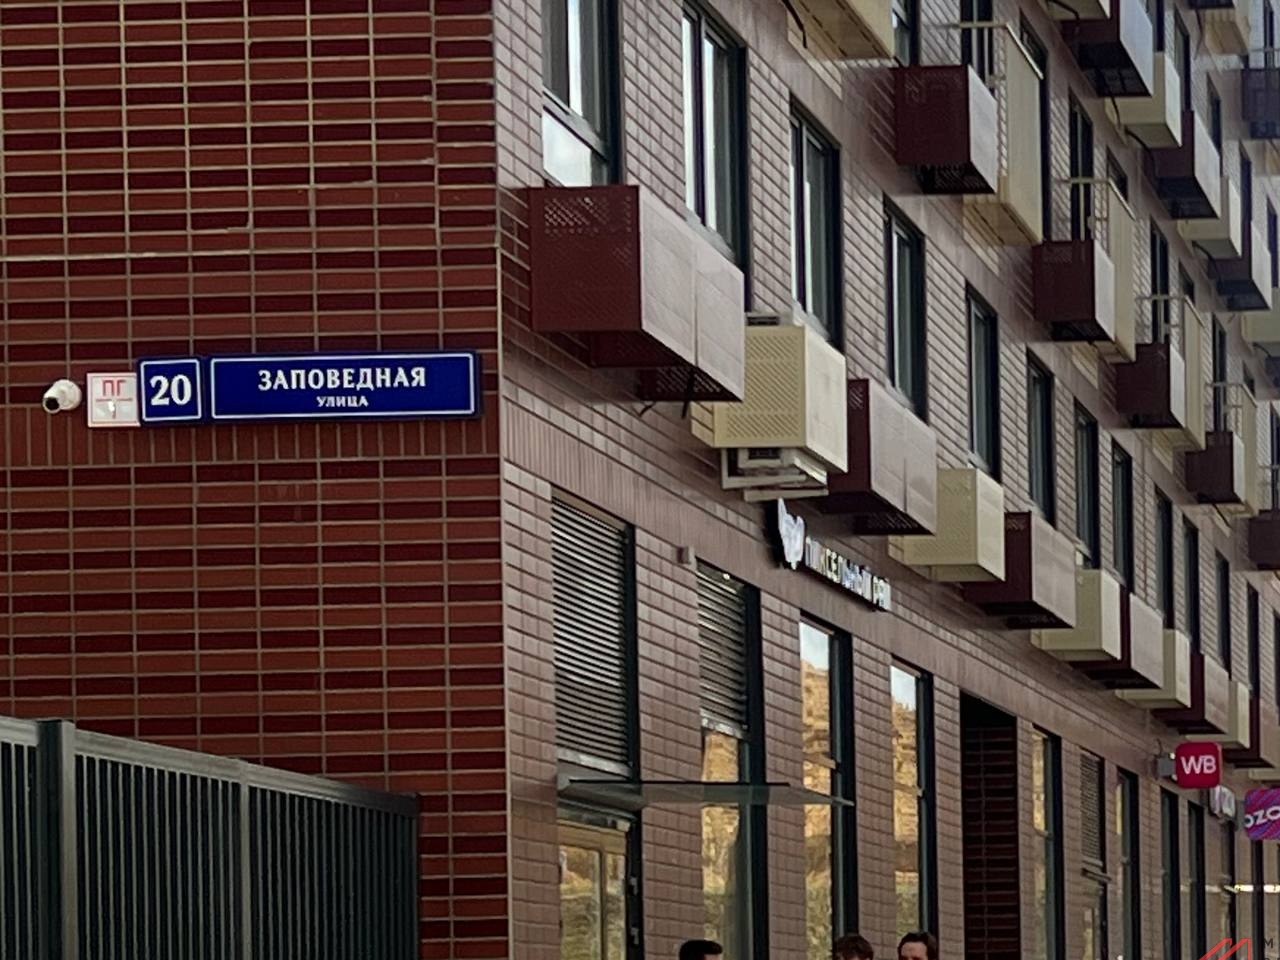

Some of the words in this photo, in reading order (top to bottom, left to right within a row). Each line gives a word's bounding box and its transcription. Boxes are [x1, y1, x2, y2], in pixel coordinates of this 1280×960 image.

[101, 378, 127, 397] ПГ
[257, 366, 427, 391] ЗАПОВЕДНАЯ
[149, 374, 192, 406] 20
[316, 395, 369, 408] УЛИЦА
[1180, 754, 1217, 775] WB
